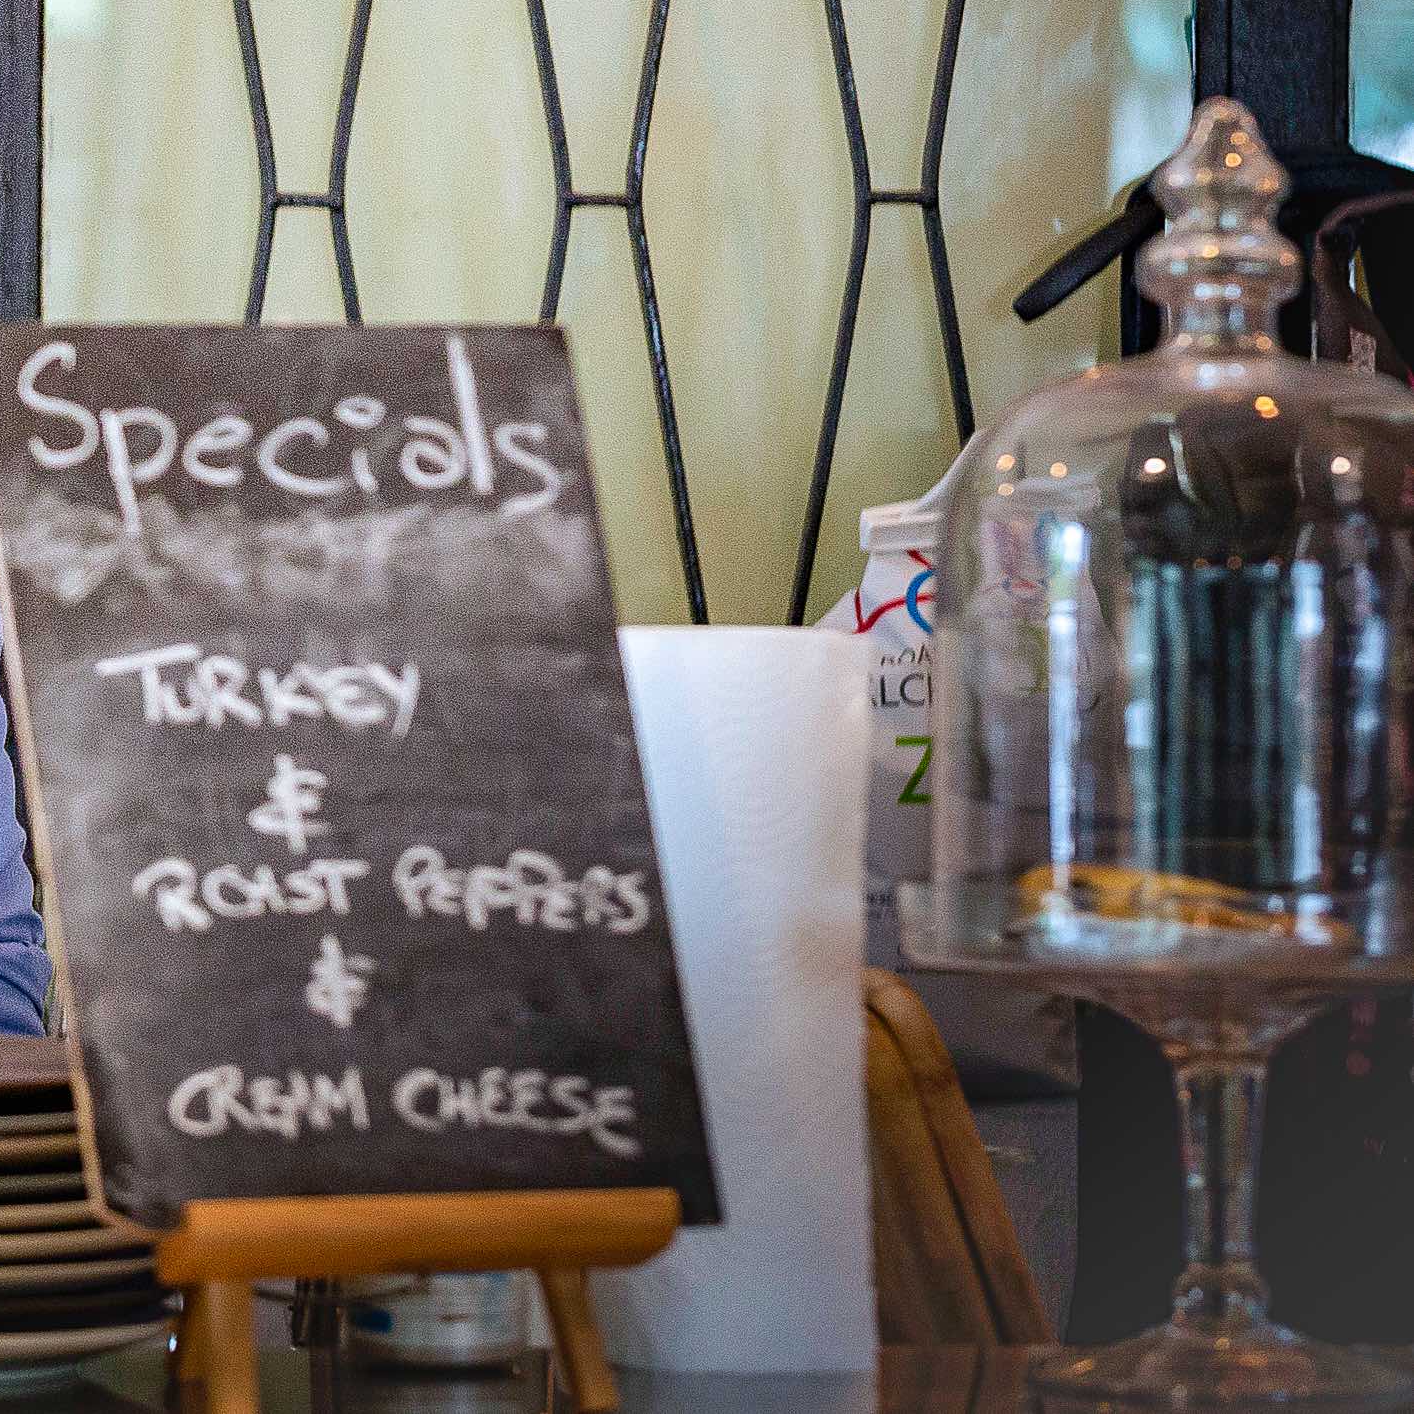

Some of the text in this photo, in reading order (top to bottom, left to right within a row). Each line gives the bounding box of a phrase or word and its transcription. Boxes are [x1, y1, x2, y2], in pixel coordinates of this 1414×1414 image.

[18, 333, 562, 536] Specials
[97, 643, 420, 739] TURKEY
[132, 845, 652, 934] ROAST PEPPERS
[168, 1064, 646, 1160] CREAM CHEESE
